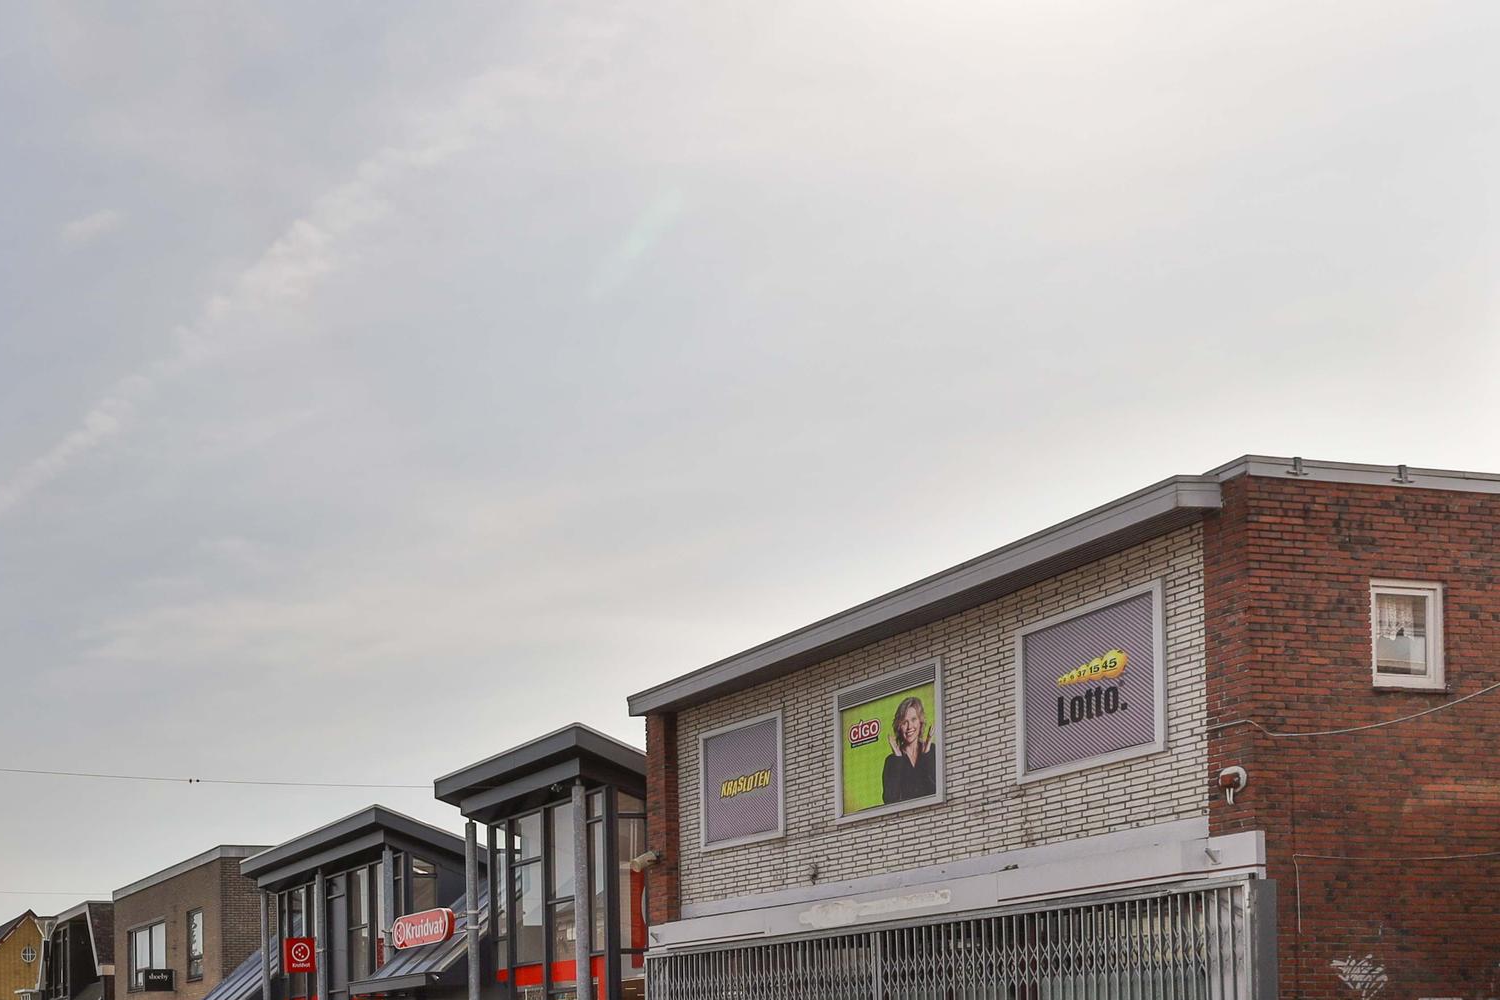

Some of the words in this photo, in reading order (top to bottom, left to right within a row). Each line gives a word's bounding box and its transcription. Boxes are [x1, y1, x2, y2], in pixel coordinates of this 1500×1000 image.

[1077, 669, 1087, 678] 37
[1089, 664, 1100, 674] 15
[1101, 657, 1118, 670] 45
[1057, 686, 1128, 727] Lotto.
[719, 769, 772, 799] KRASLOTEN
[404, 915, 444, 941] Kruidvat
[148, 973, 169, 981] shoeby
